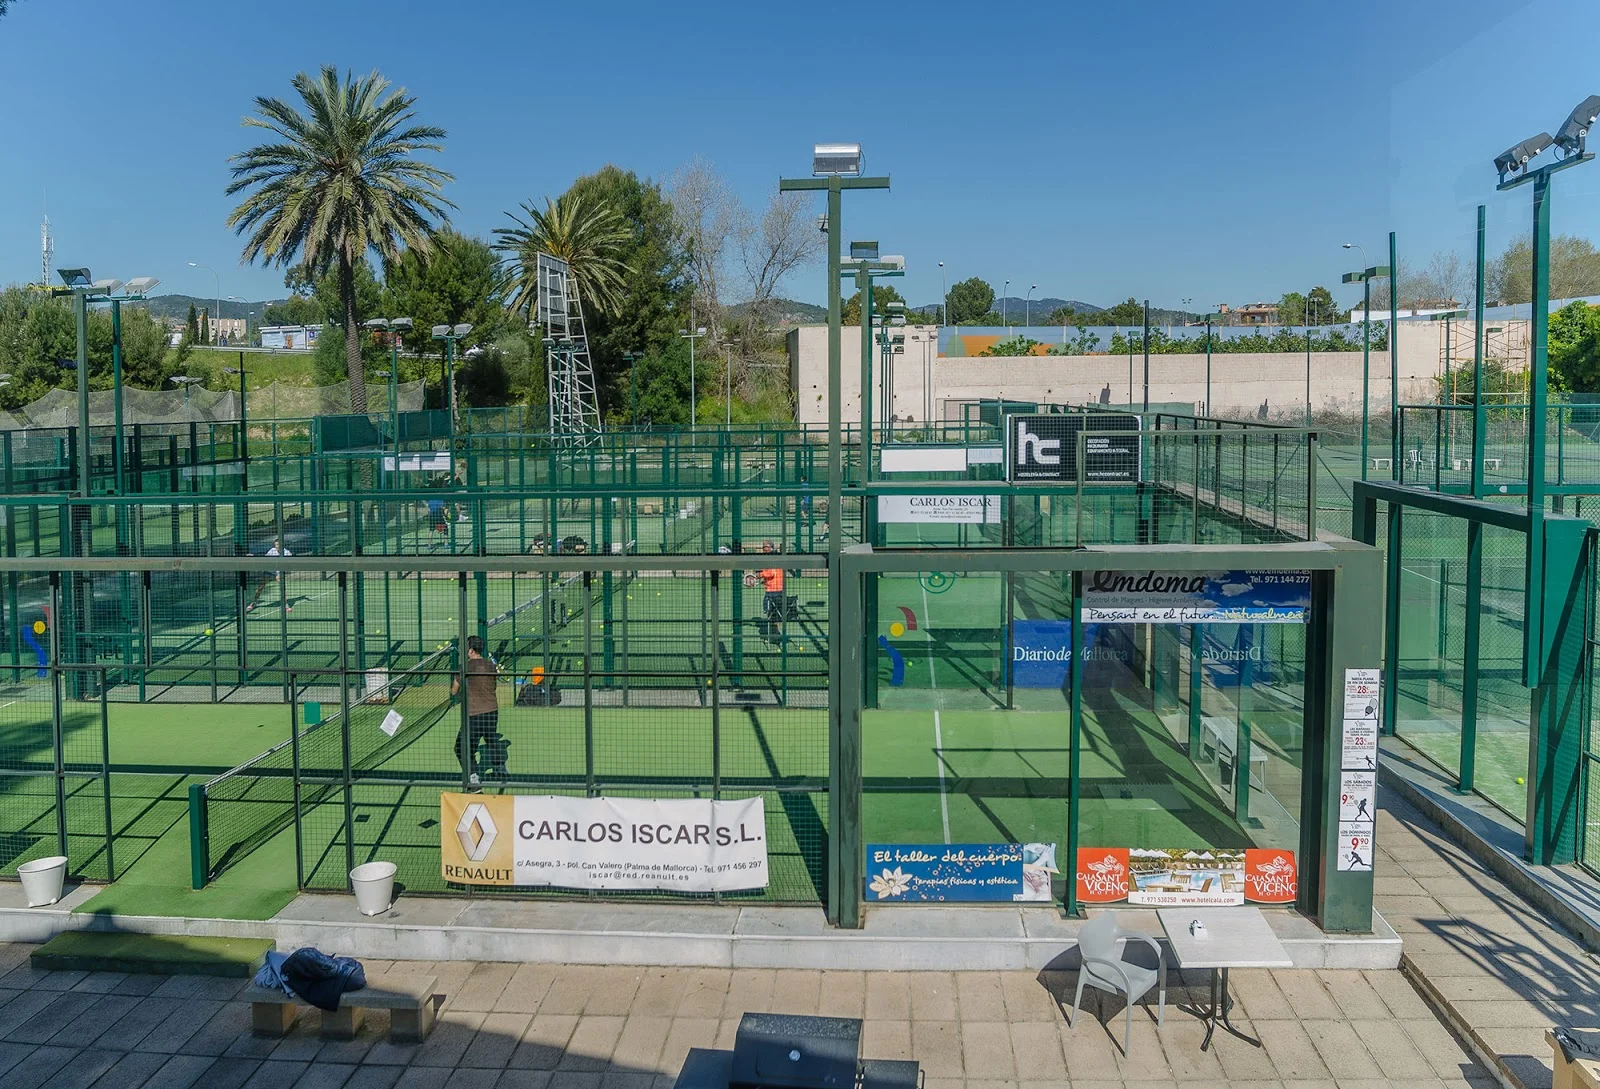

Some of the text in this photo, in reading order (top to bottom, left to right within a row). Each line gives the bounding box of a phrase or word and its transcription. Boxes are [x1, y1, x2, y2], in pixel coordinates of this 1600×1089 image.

[1018, 422, 1060, 464] hc
[910, 497, 992, 507] CARLOS ISCAR
[1250, 575, 1310, 584] Tel. 971 144 277
[1088, 608, 1138, 621] Pensant
[1164, 608, 1176, 620] el
[518, 820, 762, 846] CARLOS ISCAR S.L.
[874, 850, 1018, 866] El taller del cuerpo
[445, 864, 512, 880] RENAULT
[526, 860, 554, 869] Asegra,
[567, 861, 580, 870] pol.
[582, 862, 596, 870] Can
[599, 862, 622, 870] Valero
[624, 863, 650, 871] (Palma
[662, 864, 698, 873] Mallorca)
[704, 865, 716, 874] Tel.
[718, 864, 730, 872] 971
[732, 862, 746, 870] 456
[748, 861, 762, 869] 297
[912, 876, 948, 886] terapias
[979, 878, 984, 886] y
[1084, 880, 1128, 894] VICENÇ
[1254, 882, 1297, 894] VICENÇ
[1182, 896, 1236, 904] www.hotelcala.com
